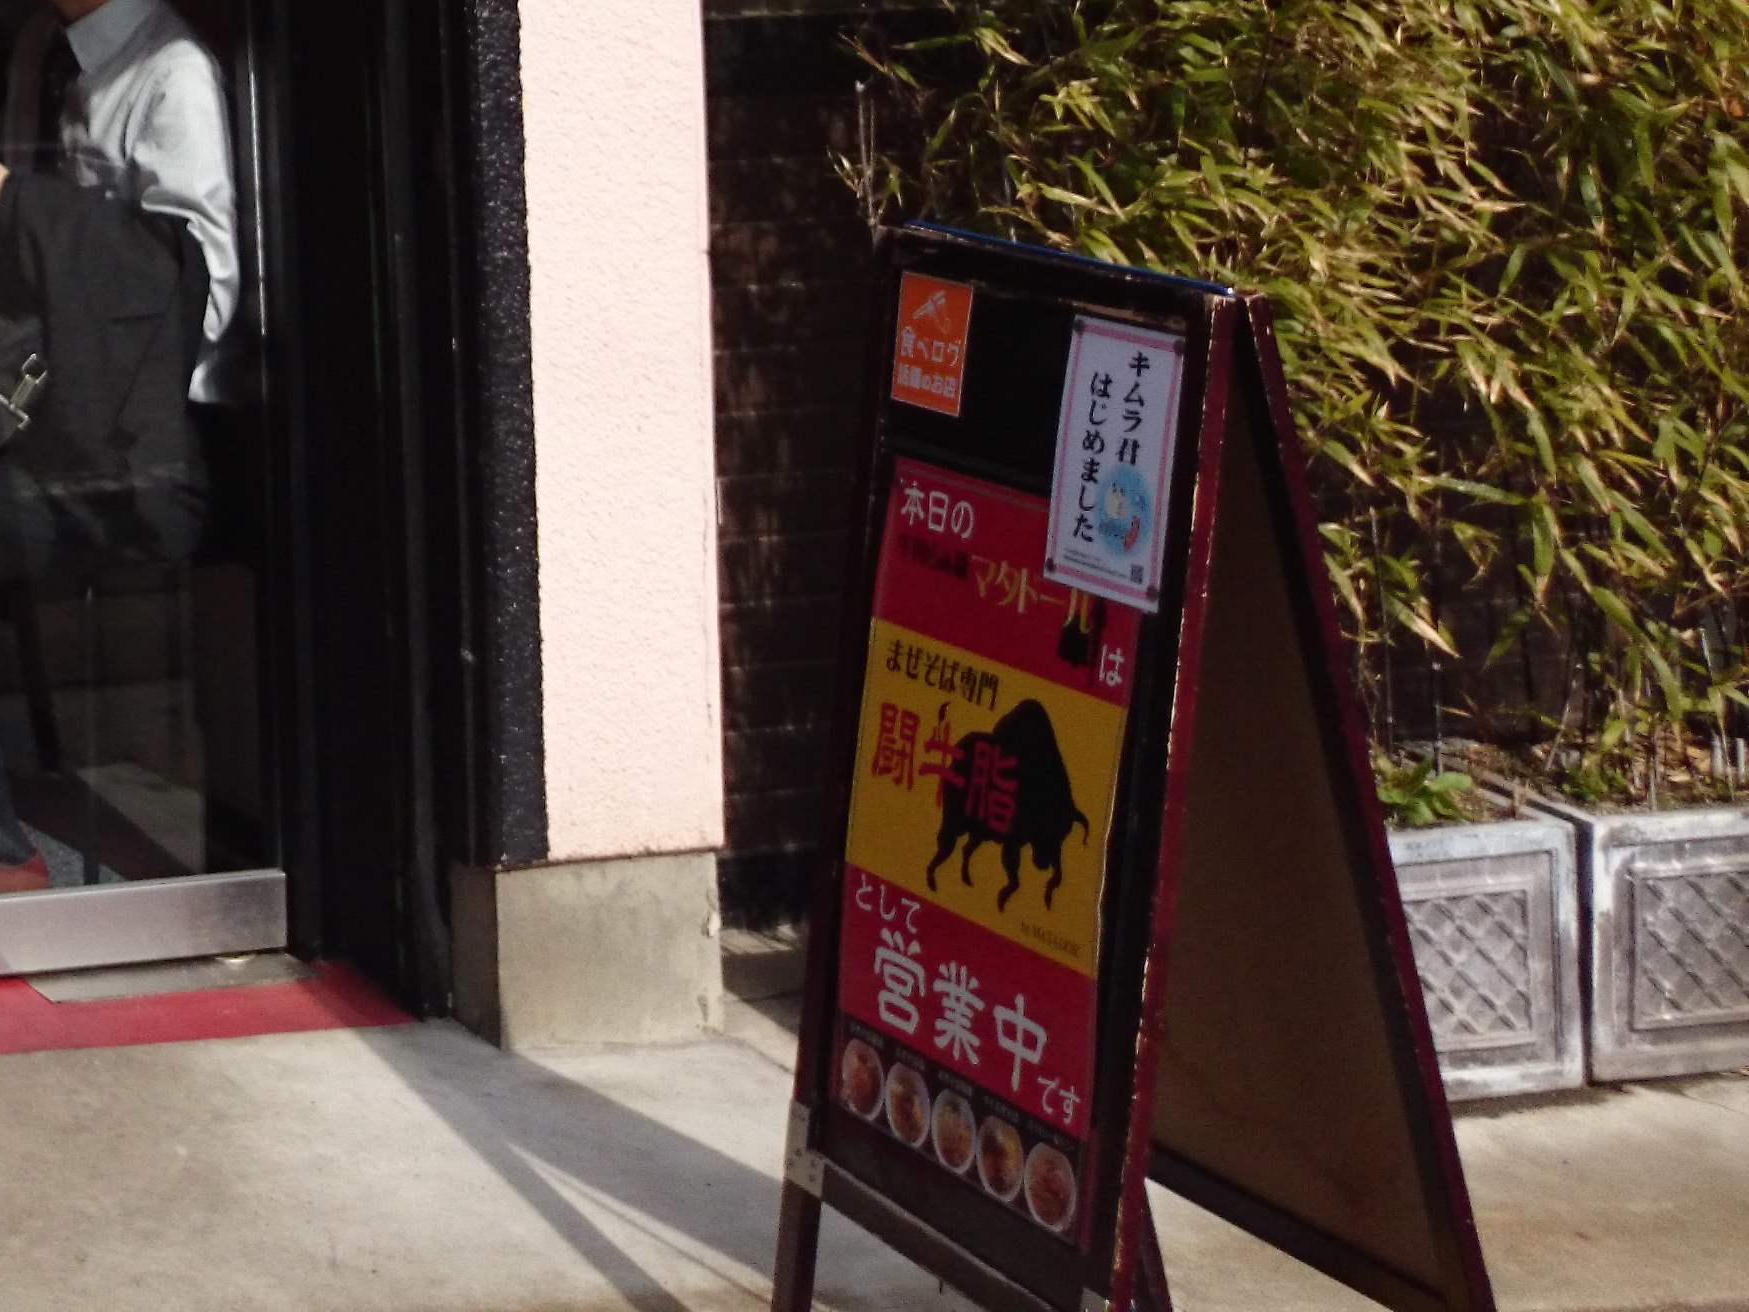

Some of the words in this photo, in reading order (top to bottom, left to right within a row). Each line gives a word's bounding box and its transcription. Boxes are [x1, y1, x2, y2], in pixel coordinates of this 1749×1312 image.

[900, 325, 962, 368] 食べログ
[1072, 370, 1114, 543] はじめました
[901, 480, 975, 539] 本日の
[885, 638, 1000, 712] まぜそば専門
[1098, 643, 1125, 688] は
[871, 701, 1019, 834] 闘牛脂
[854, 873, 921, 934] として
[873, 927, 1048, 1093] 営業中
[1037, 1076, 1081, 1125] です
